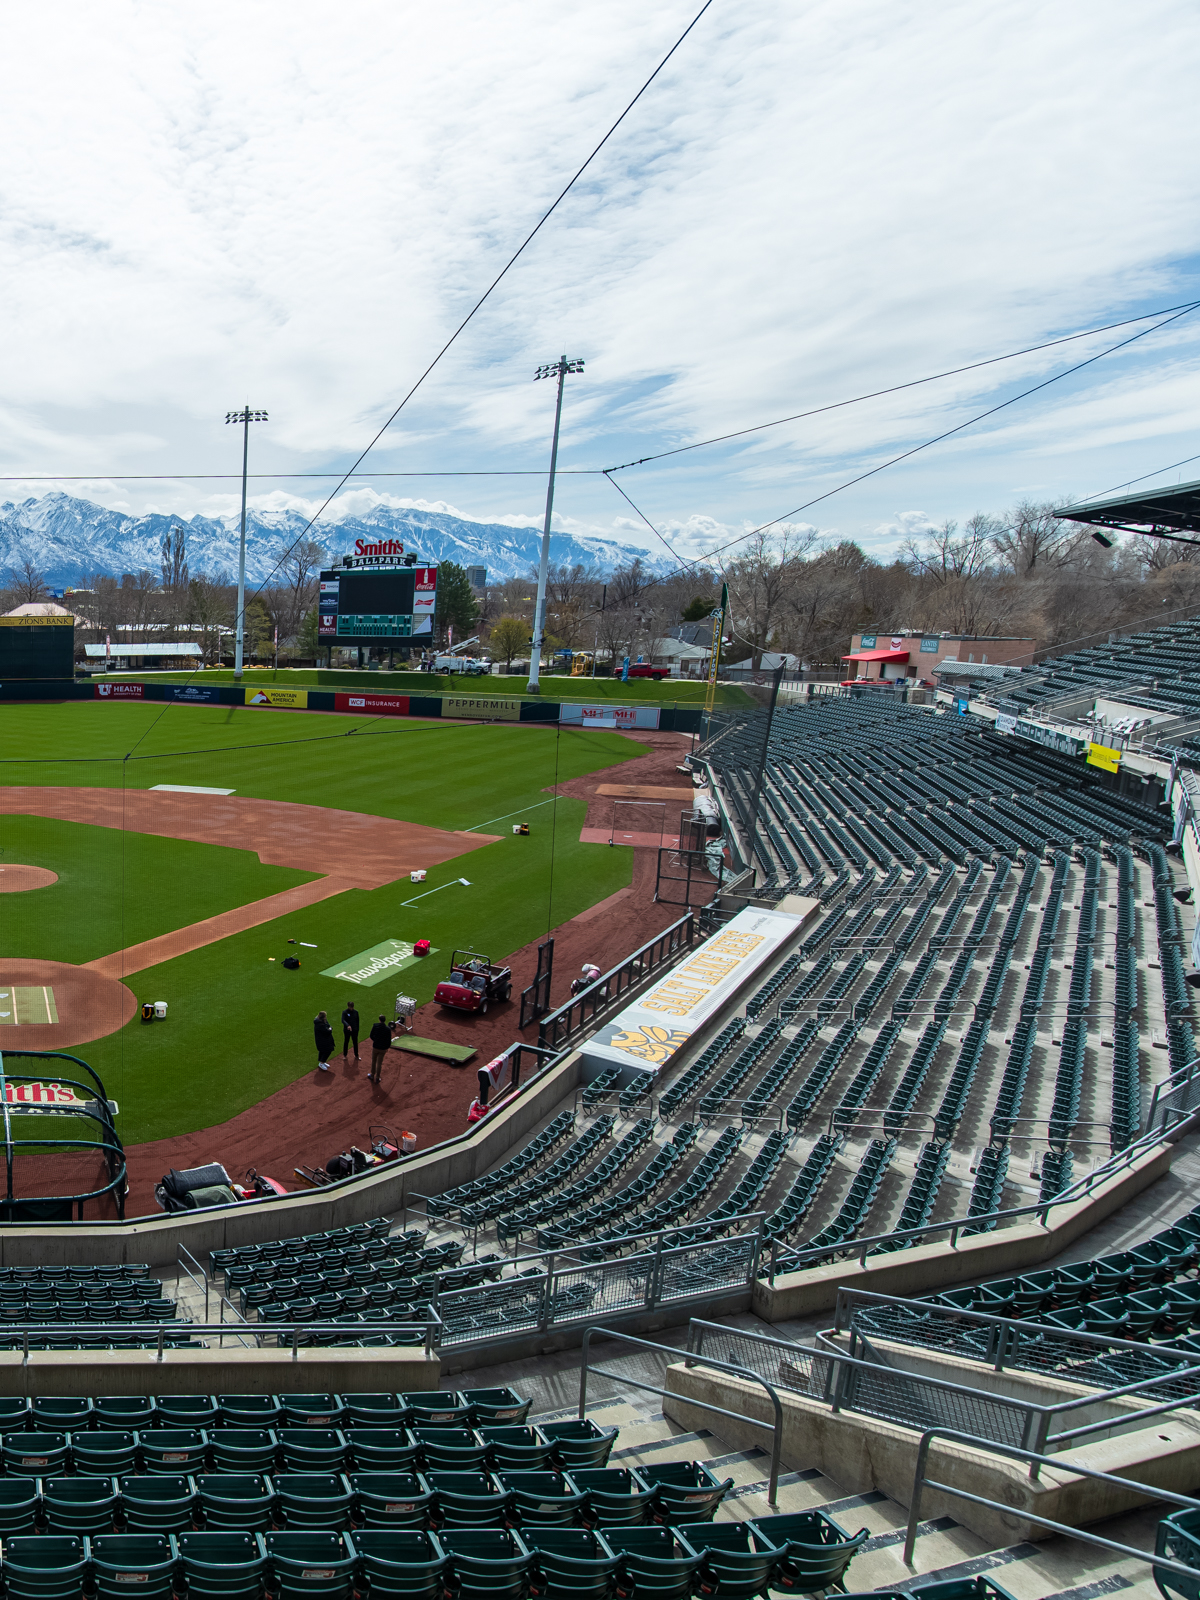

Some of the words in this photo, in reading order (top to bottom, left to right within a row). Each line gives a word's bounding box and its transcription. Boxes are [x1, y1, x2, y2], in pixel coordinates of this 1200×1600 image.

[355, 539, 404, 556] Smith's
[351, 557, 407, 567] BALLPARK
[448, 699, 516, 710] PEPPERMILL
[705, 930, 766, 958] BEES
[335, 948, 414, 984] Travelpass
[675, 953, 741, 986] LAKE
[641, 979, 711, 1016] SALT
